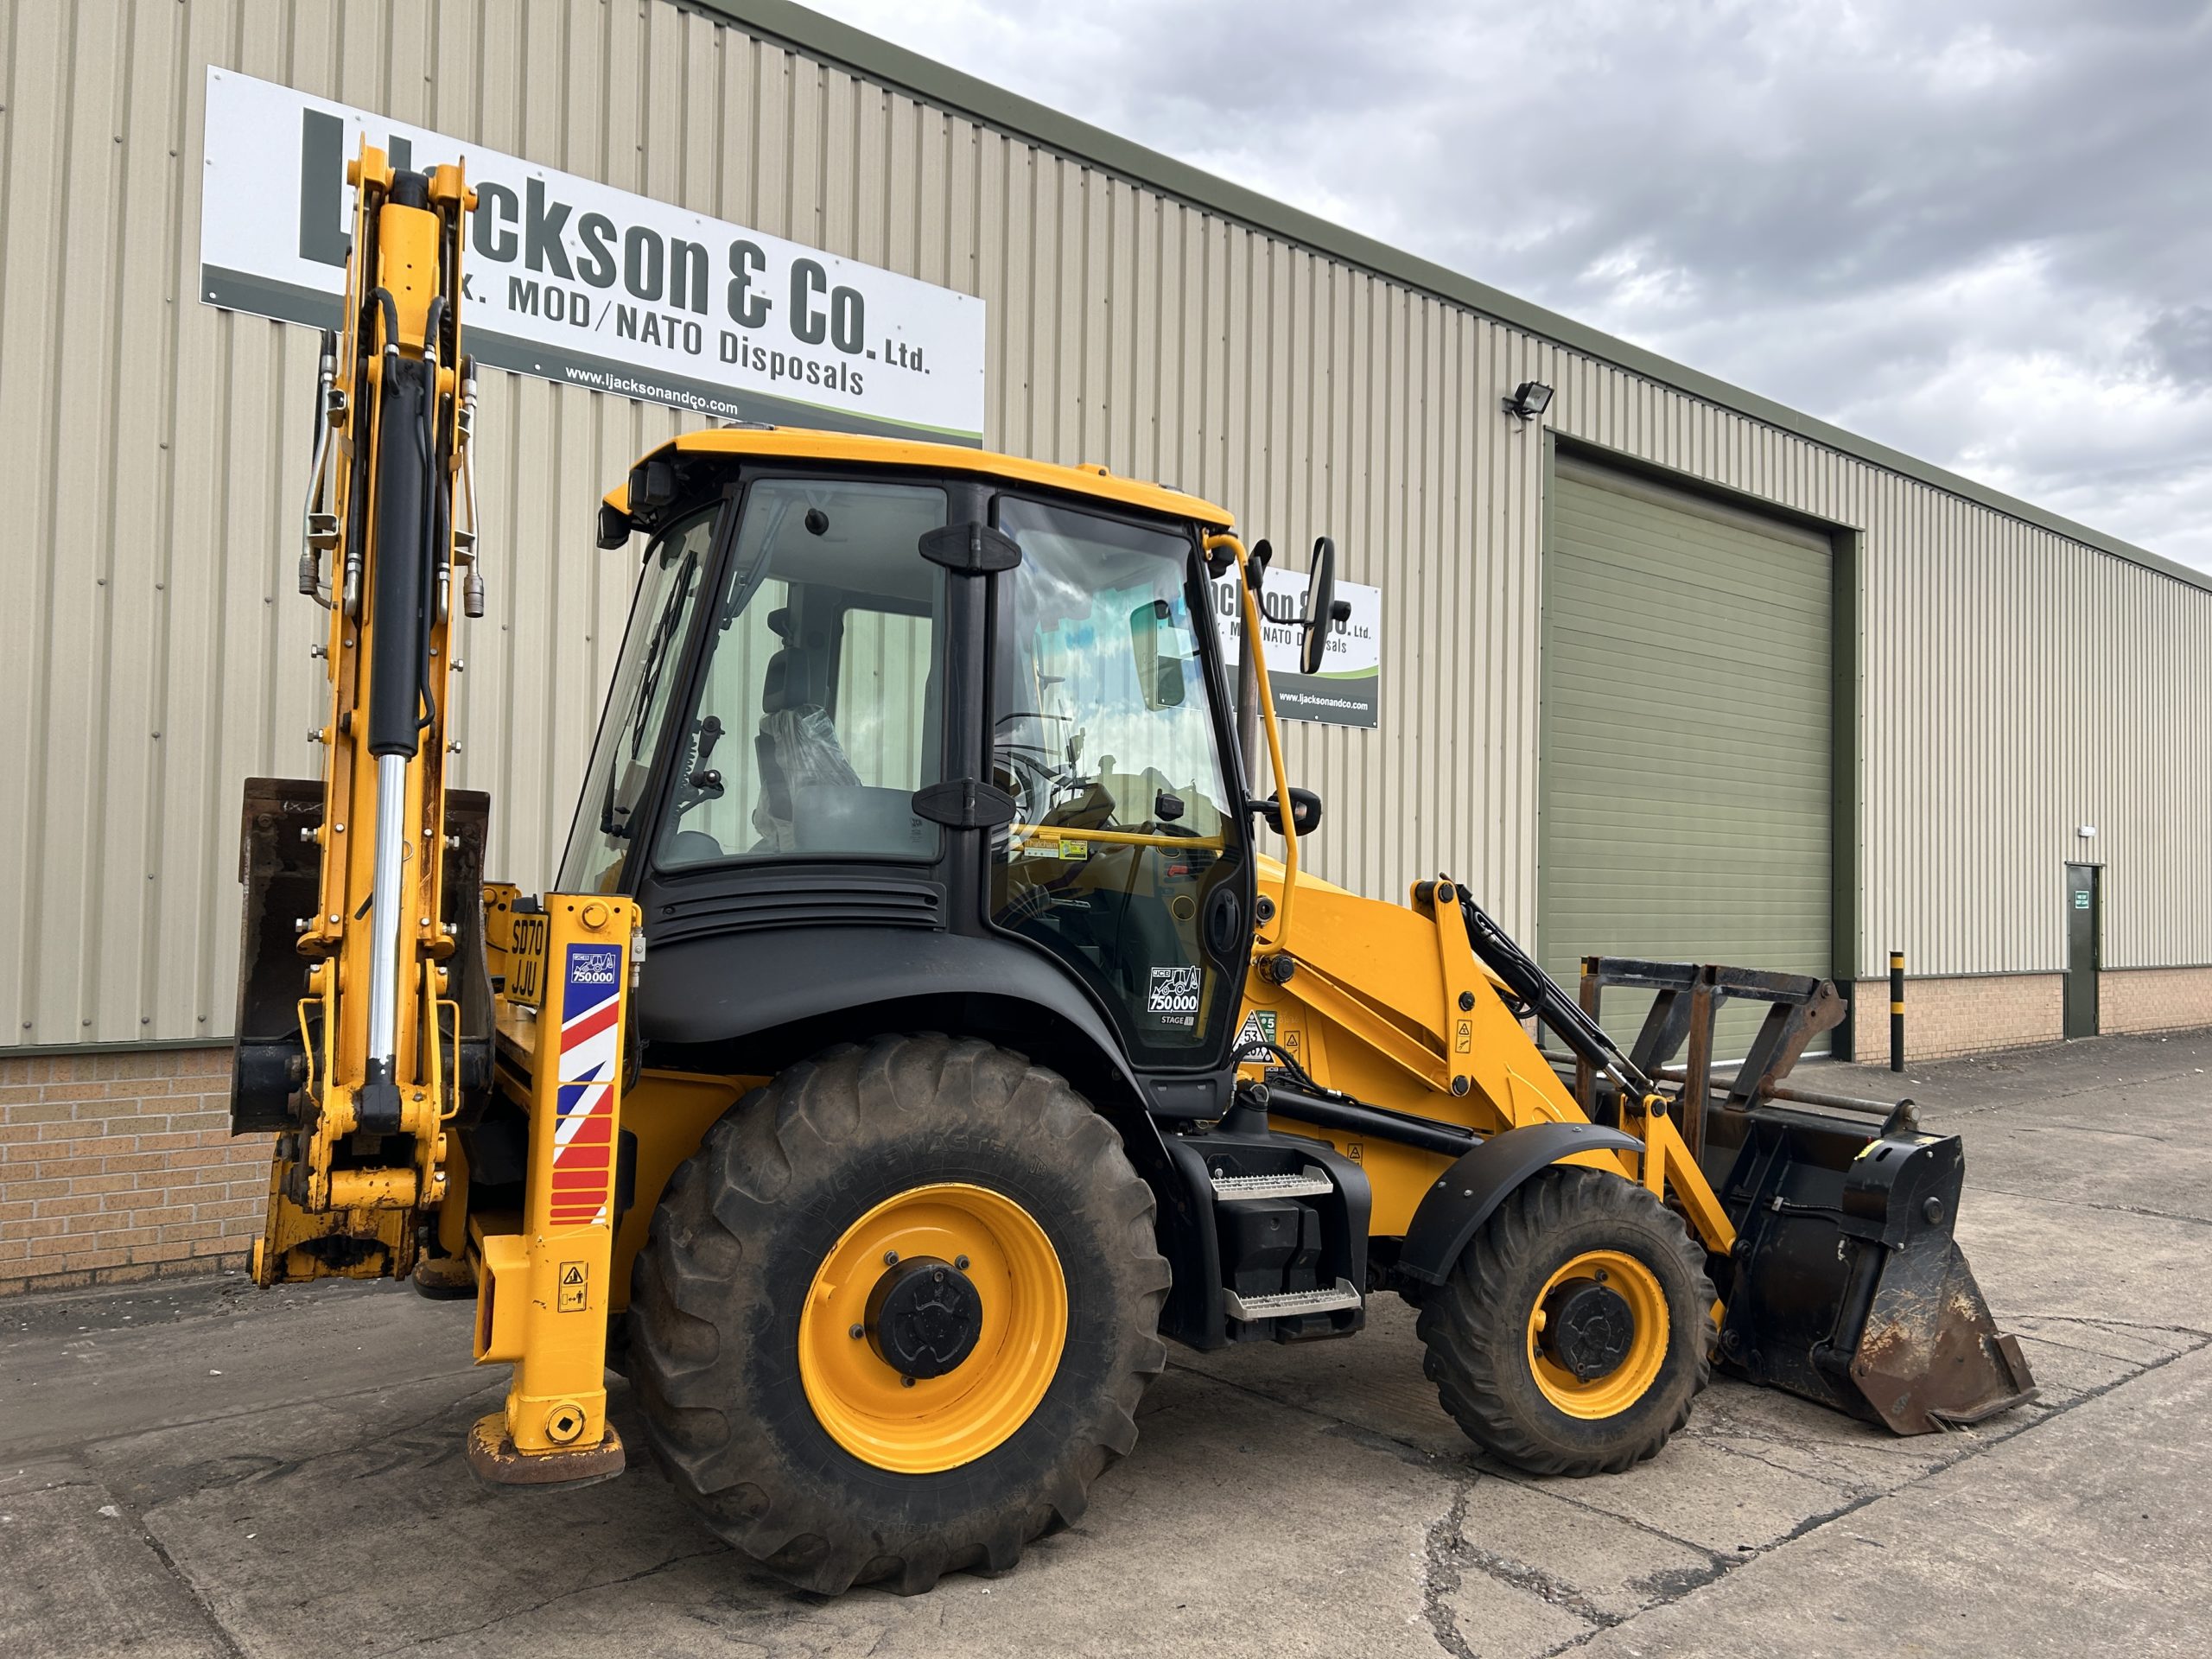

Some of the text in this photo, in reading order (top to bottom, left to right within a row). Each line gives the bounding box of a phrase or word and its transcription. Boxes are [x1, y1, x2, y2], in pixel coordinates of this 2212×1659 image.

[728, 238, 772, 328] &
[790, 257, 876, 359] Co.
[885, 338, 930, 374] Ltd.
[508, 275, 702, 355] MOD/NATO
[720, 329, 863, 396] Disposals
[565, 366, 738, 415] www.ljacksonandco.com
[1354, 626, 1371, 639] Ltd.
[1279, 692, 1368, 710] www.ljacksonandco.com
[512, 919, 543, 956] SD70
[512, 959, 537, 997] JJU
[1161, 1016, 1184, 1025] STAGE
[1268, 1018, 1274, 1028] 5
[1244, 1030, 1258, 1043] 53
